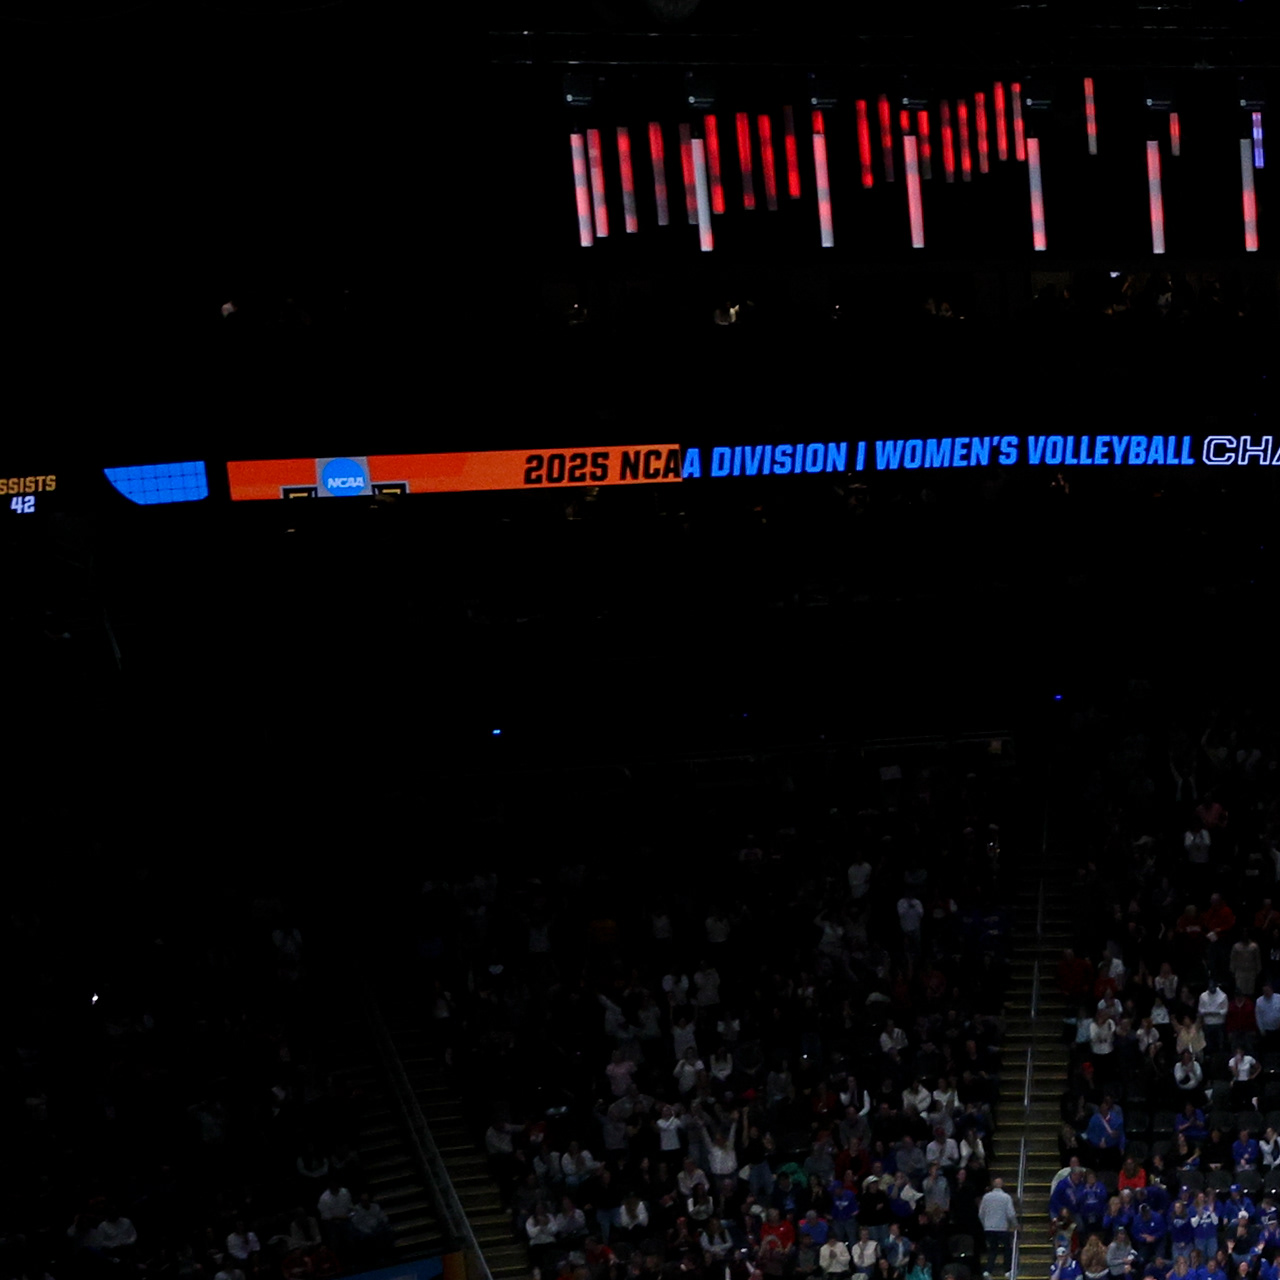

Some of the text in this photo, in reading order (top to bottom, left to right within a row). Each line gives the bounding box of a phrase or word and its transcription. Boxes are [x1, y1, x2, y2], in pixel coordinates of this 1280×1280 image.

[523, 450, 611, 486] 2025
[618, 446, 701, 481] NCAA
[711, 442, 847, 478] DIVISION
[875, 436, 1018, 472] WOMEN'S
[1027, 434, 1196, 468] VOLLEYBALL
[327, 475, 364, 489] NCAA
[10, 495, 36, 514] 42
